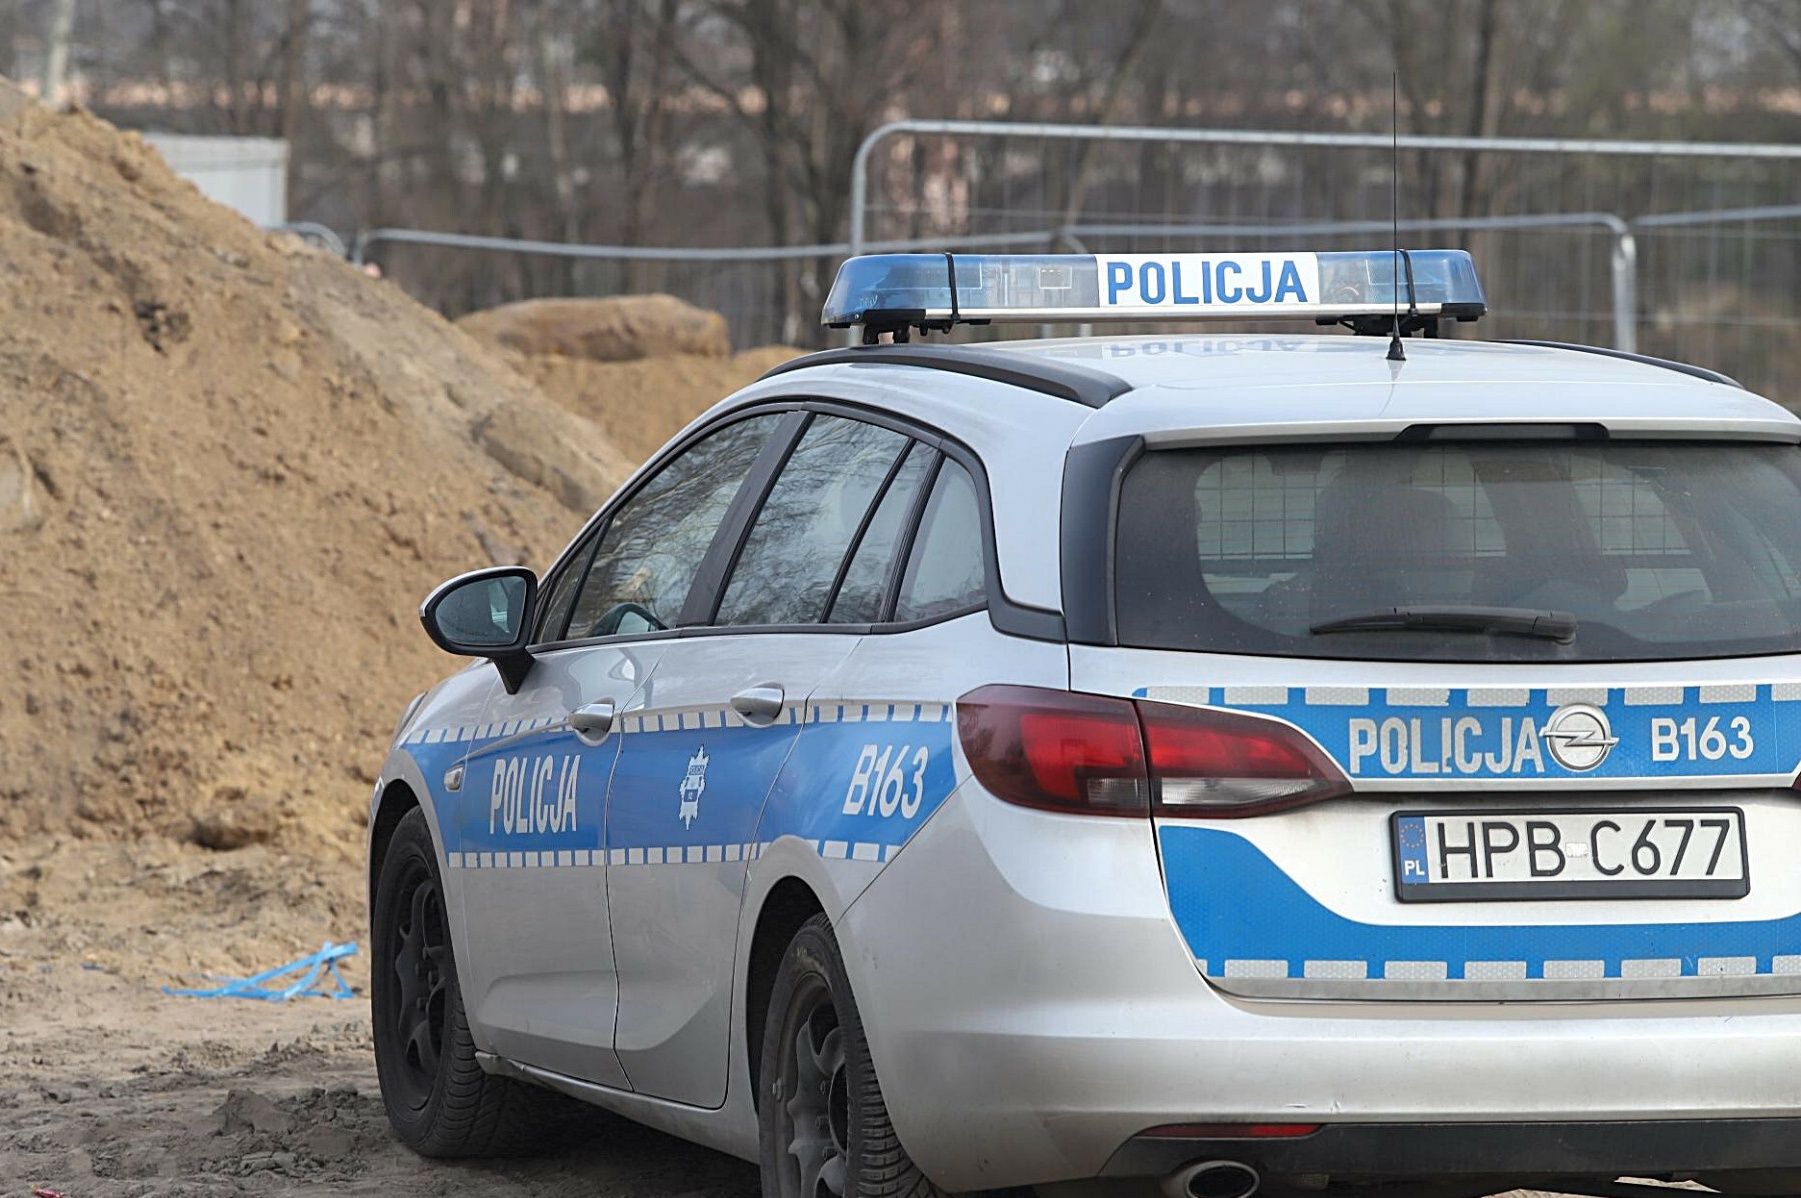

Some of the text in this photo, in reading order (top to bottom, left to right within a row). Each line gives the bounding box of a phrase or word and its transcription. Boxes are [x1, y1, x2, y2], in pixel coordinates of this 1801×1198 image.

[1107, 260, 1308, 305] POLICJA
[1349, 716, 1754, 774] POLICJA B163
[489, 755, 582, 834] POLICJA
[842, 744, 930, 818] B163
[1404, 860, 1425, 876] PL
[1437, 819, 1731, 878] HPB C677
